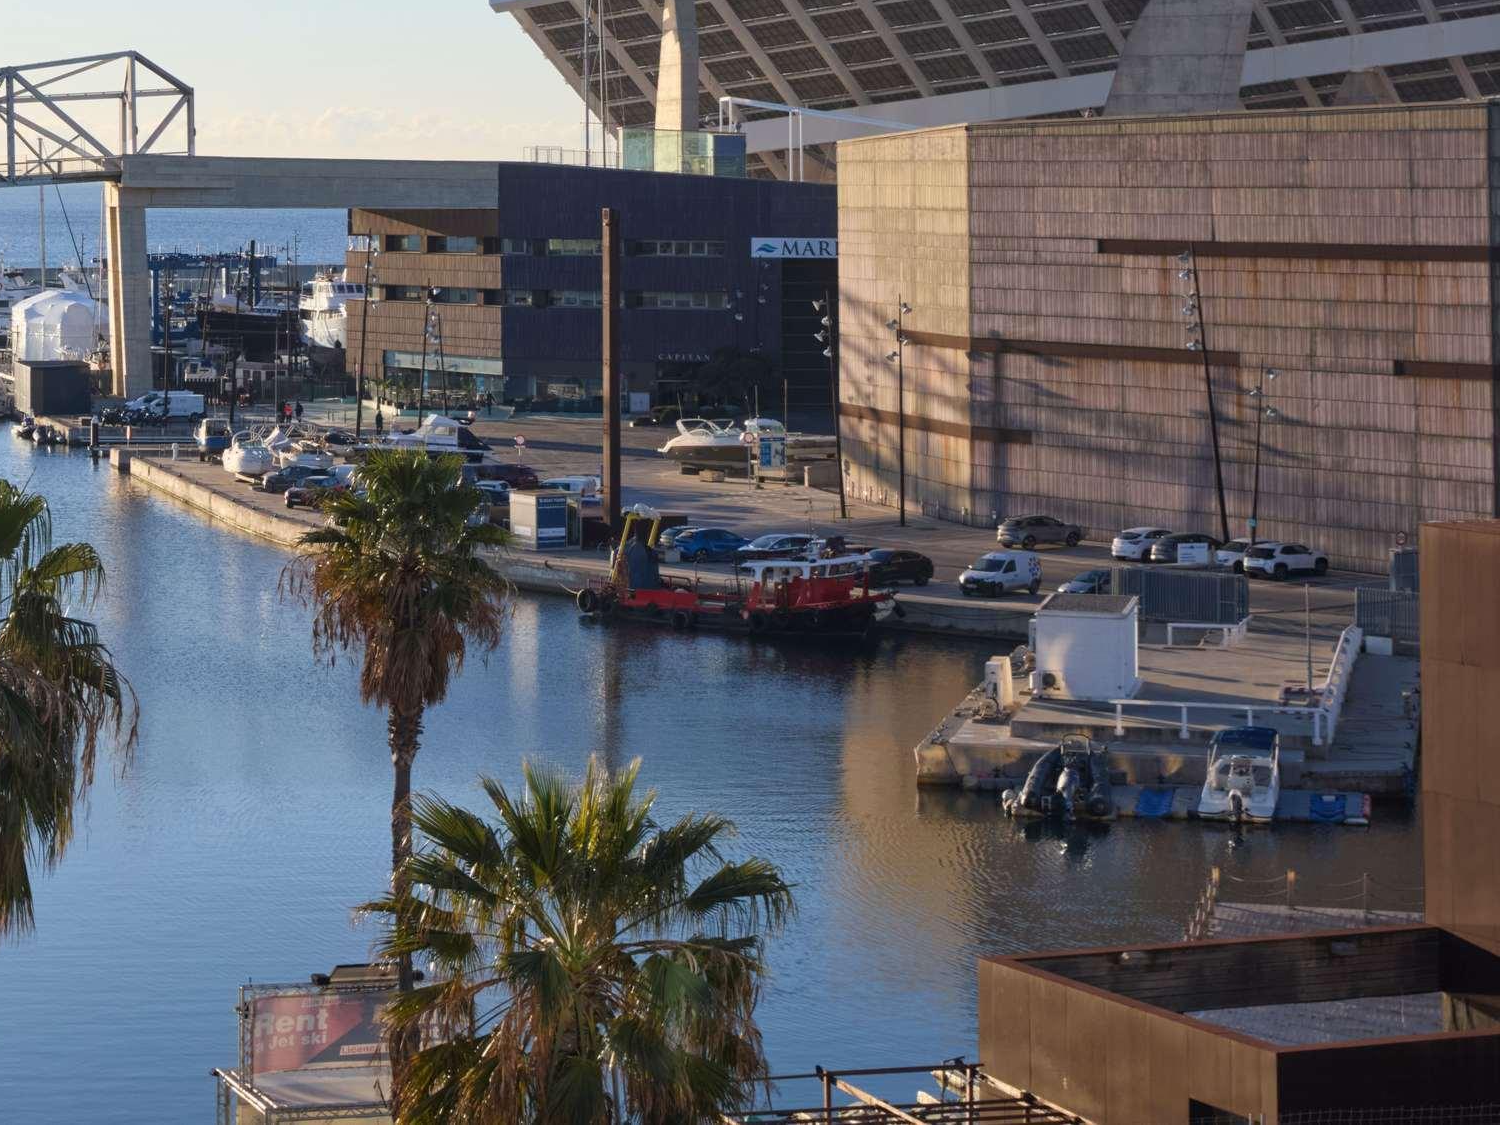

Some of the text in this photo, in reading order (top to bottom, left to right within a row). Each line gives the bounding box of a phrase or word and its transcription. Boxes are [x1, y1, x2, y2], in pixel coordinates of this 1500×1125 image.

[254, 1008, 329, 1037] Rent
[268, 1034, 295, 1051] Jet
[301, 1031, 328, 1046] ski
